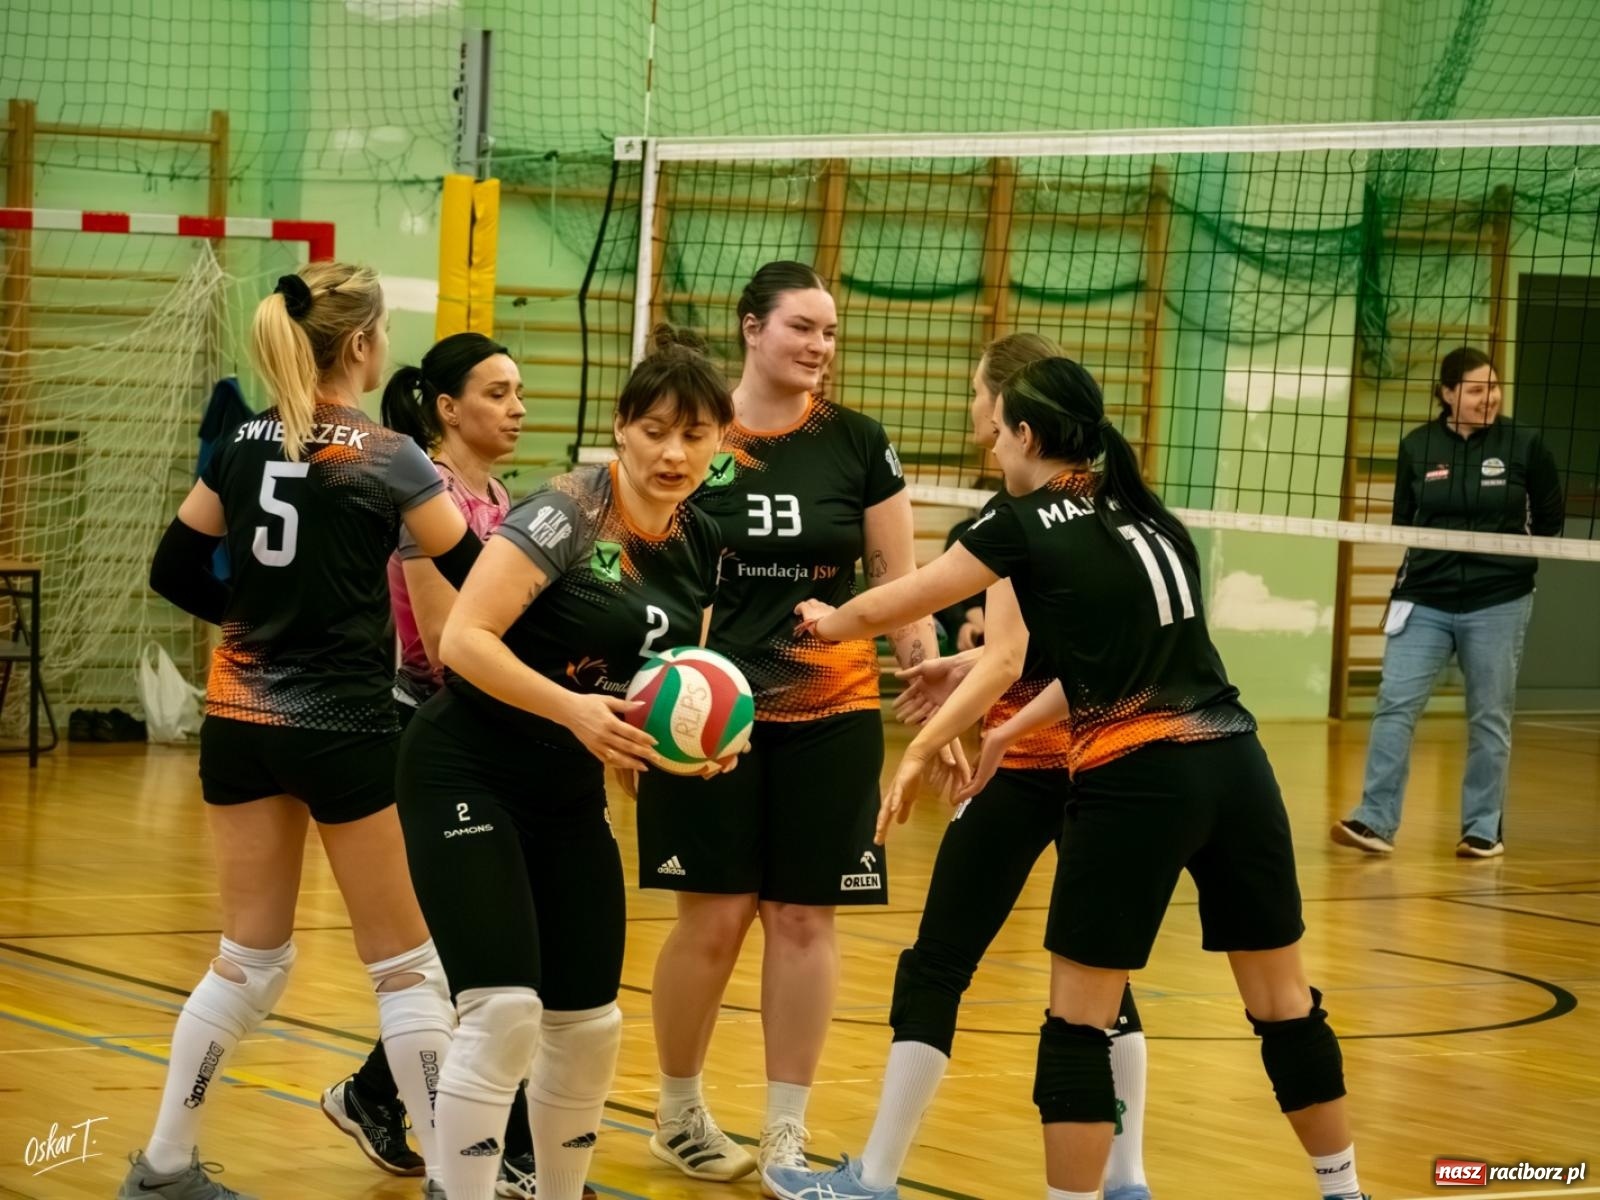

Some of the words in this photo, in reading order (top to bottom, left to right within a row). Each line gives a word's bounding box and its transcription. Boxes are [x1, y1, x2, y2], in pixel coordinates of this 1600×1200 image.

[252, 460, 310, 567] 5
[746, 493, 802, 537] 33
[737, 562, 809, 582] Fundacja
[811, 564, 841, 581] JSW
[1117, 517, 1195, 627] 11
[638, 604, 670, 658] 2
[674, 682, 708, 739] RLPS
[456, 802, 471, 822] 2
[444, 823, 494, 839] DAMONS
[657, 866, 687, 876] adidas
[843, 876, 879, 888] ORLEN
